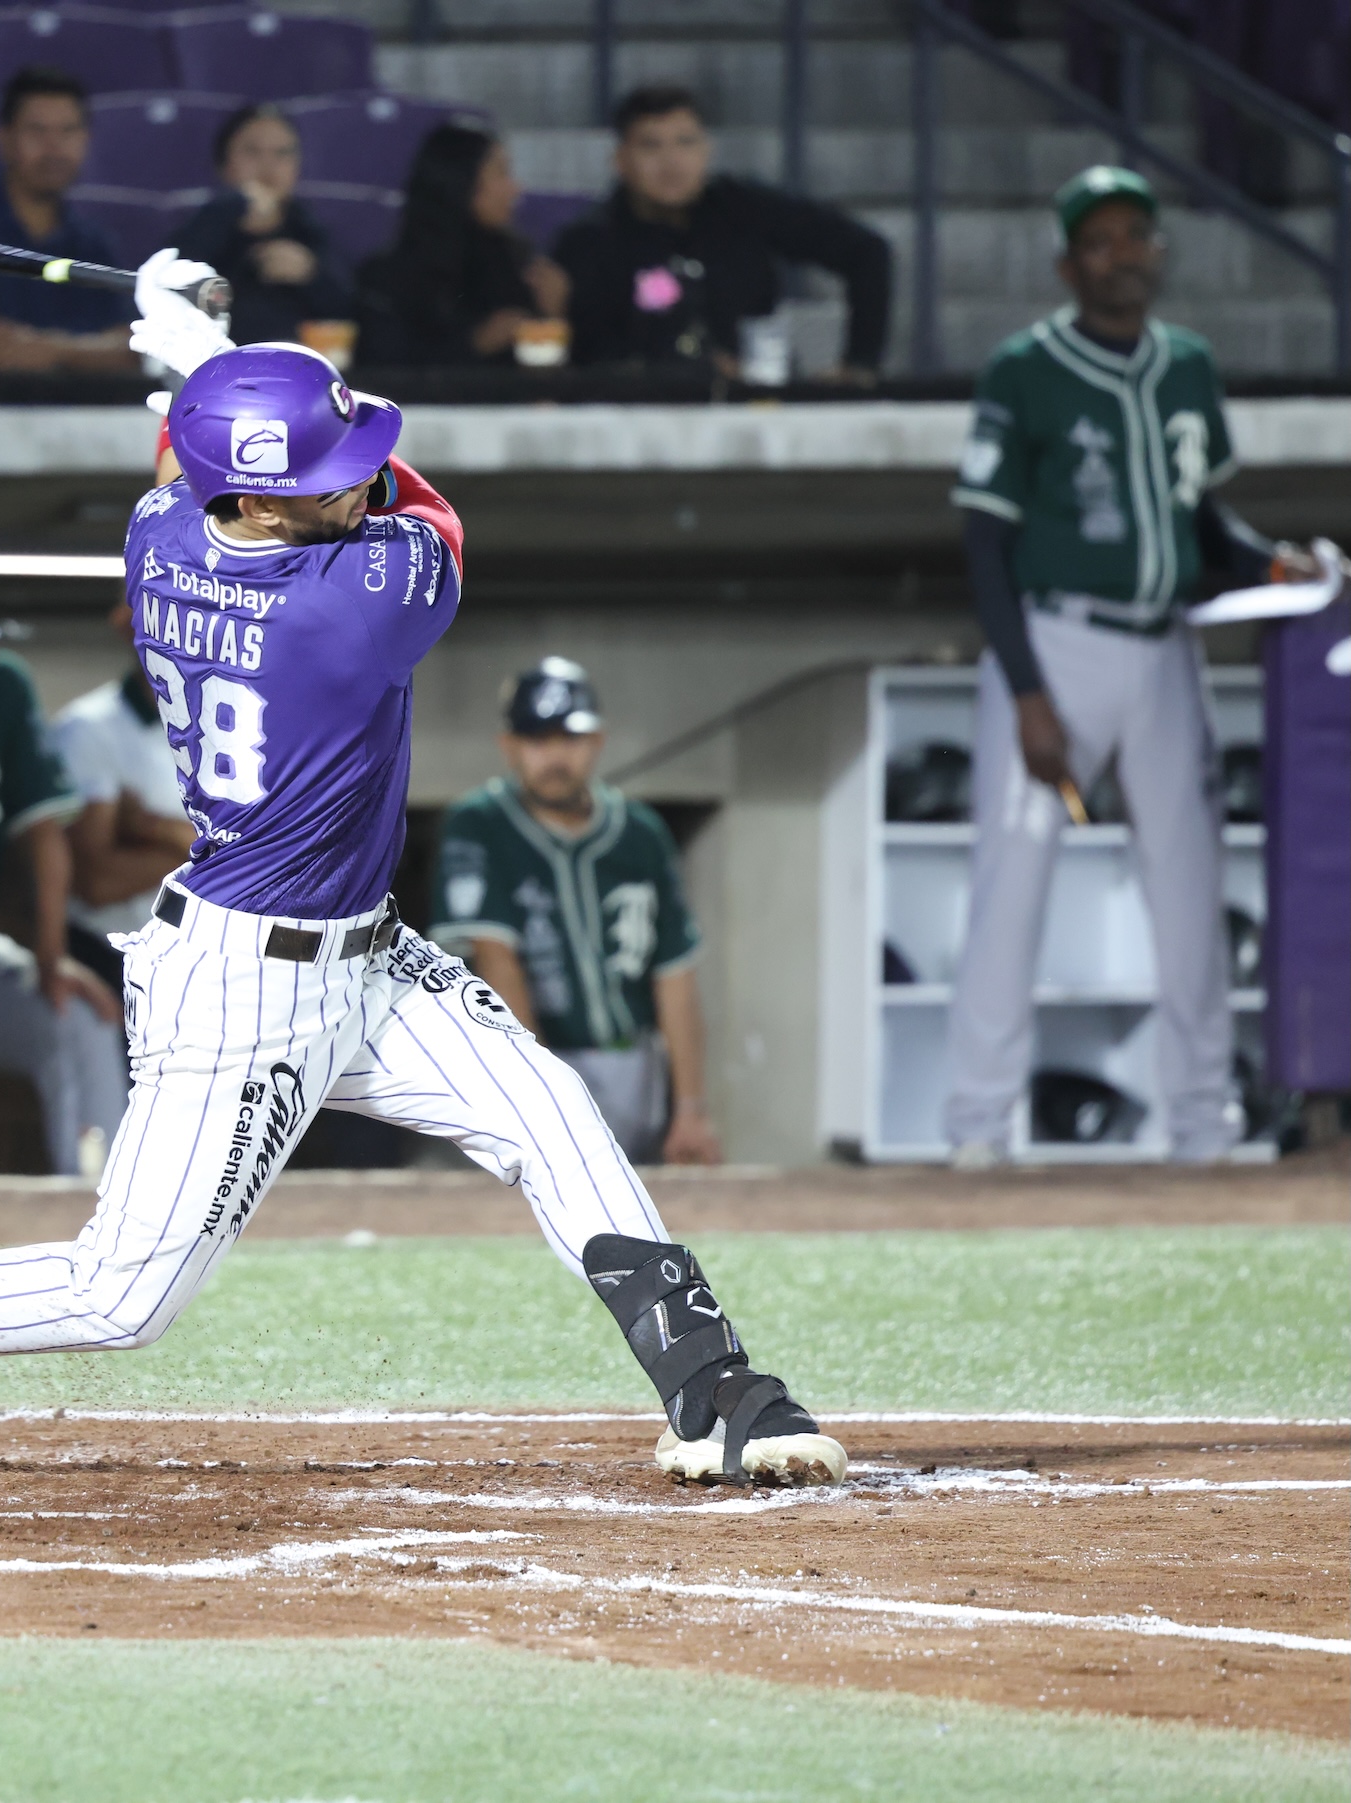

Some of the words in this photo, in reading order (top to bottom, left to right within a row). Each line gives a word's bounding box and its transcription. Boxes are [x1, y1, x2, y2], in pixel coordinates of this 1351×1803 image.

[364, 539, 387, 592] CASA
[402, 565, 418, 606] Hospital
[142, 590, 265, 672] MACIAS
[145, 646, 268, 806] 28
[200, 1105, 254, 1237] caliente.mx
